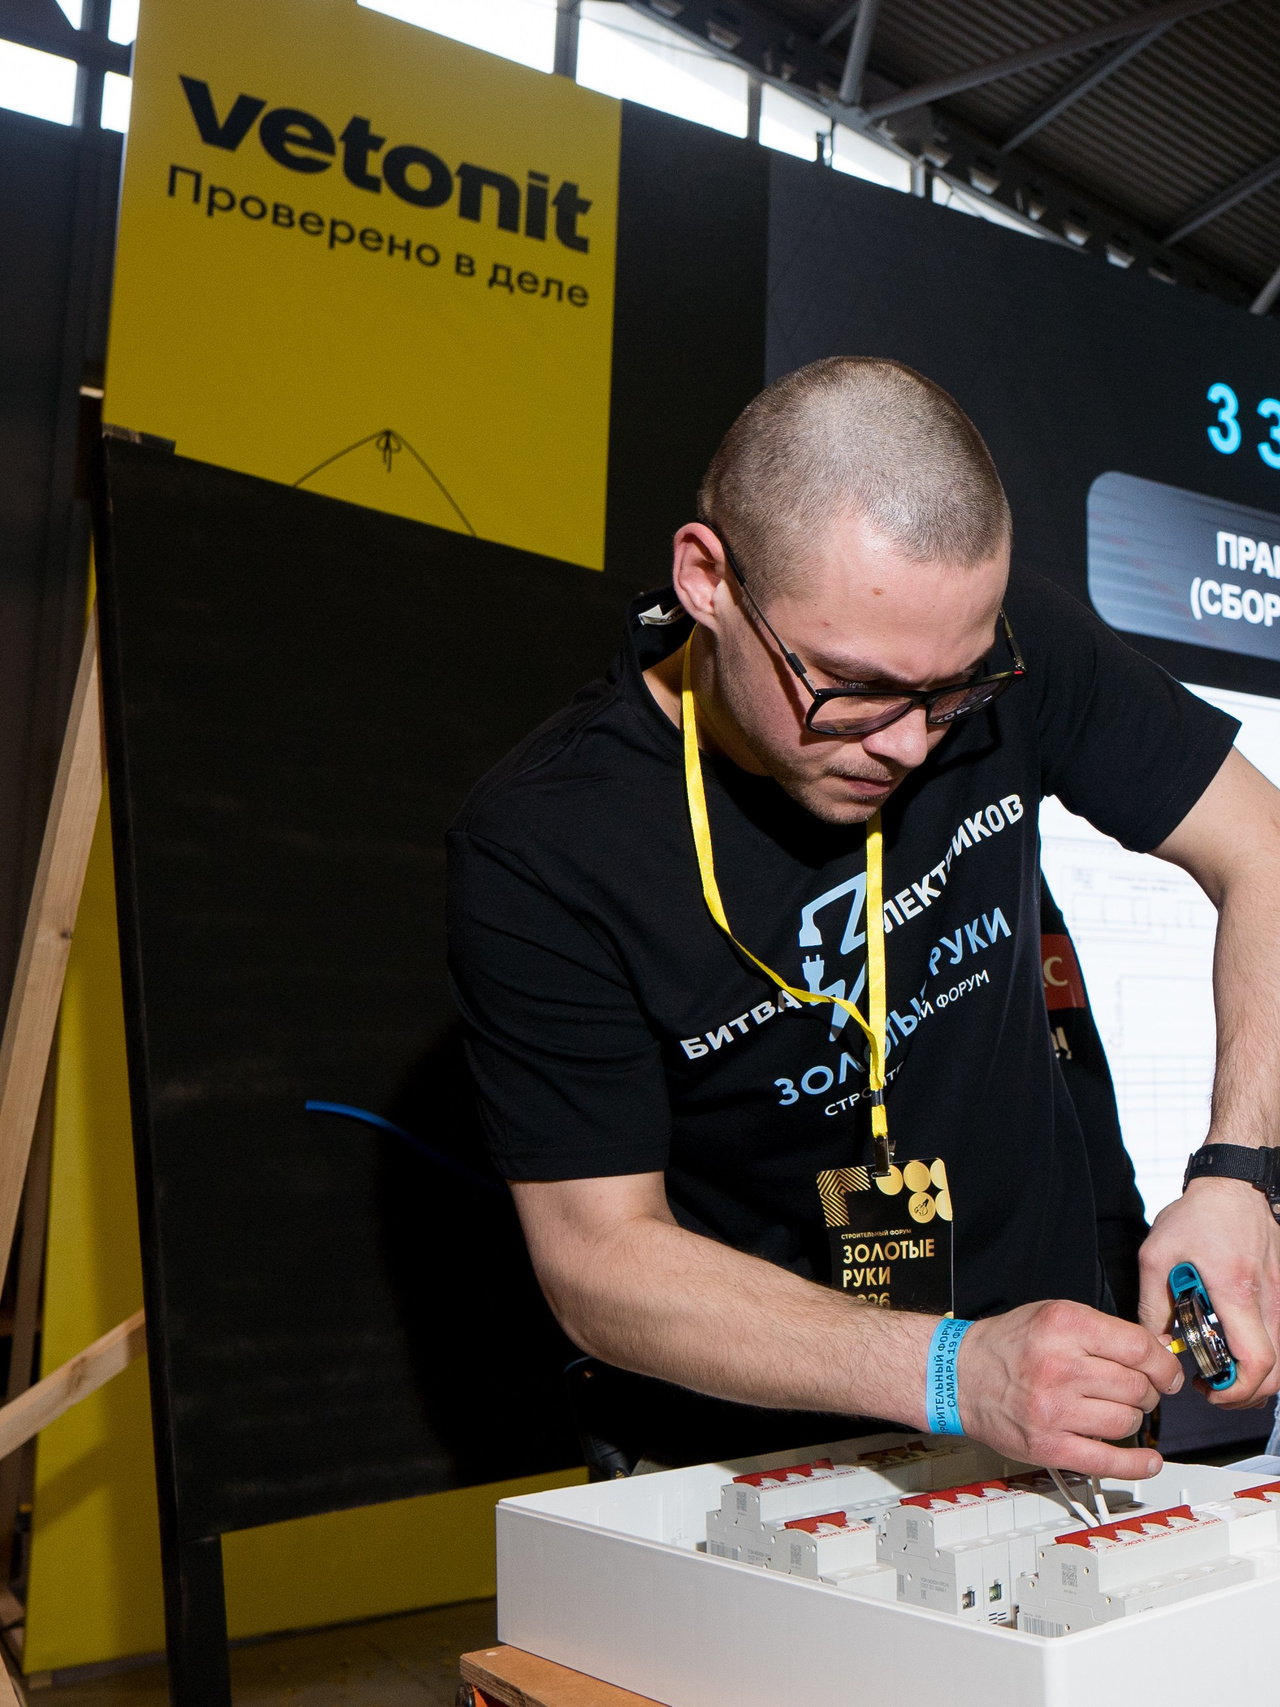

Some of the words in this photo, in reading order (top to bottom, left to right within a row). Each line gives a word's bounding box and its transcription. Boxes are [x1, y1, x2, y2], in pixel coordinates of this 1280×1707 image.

[177, 73, 592, 254] vetonit
[168, 164, 440, 267] Проверено
[455, 252, 476, 278] в
[488, 263, 590, 308] деле
[1207, 382, 1242, 455] 3
[680, 990, 803, 1060] БИТВА
[883, 794, 1024, 934] ЛЕКТРИКОВ
[929, 907, 1012, 977] РУКИ
[936, 969, 990, 1009] ФОРУМ
[843, 1238, 934, 1264] ЗОЛОТЫЕ
[889, 1228, 912, 1236] ФОРУМ
[843, 1266, 891, 1288] РУКИ
[948, 1341, 957, 1355] 19
[946, 1358, 955, 1408] САМАРА
